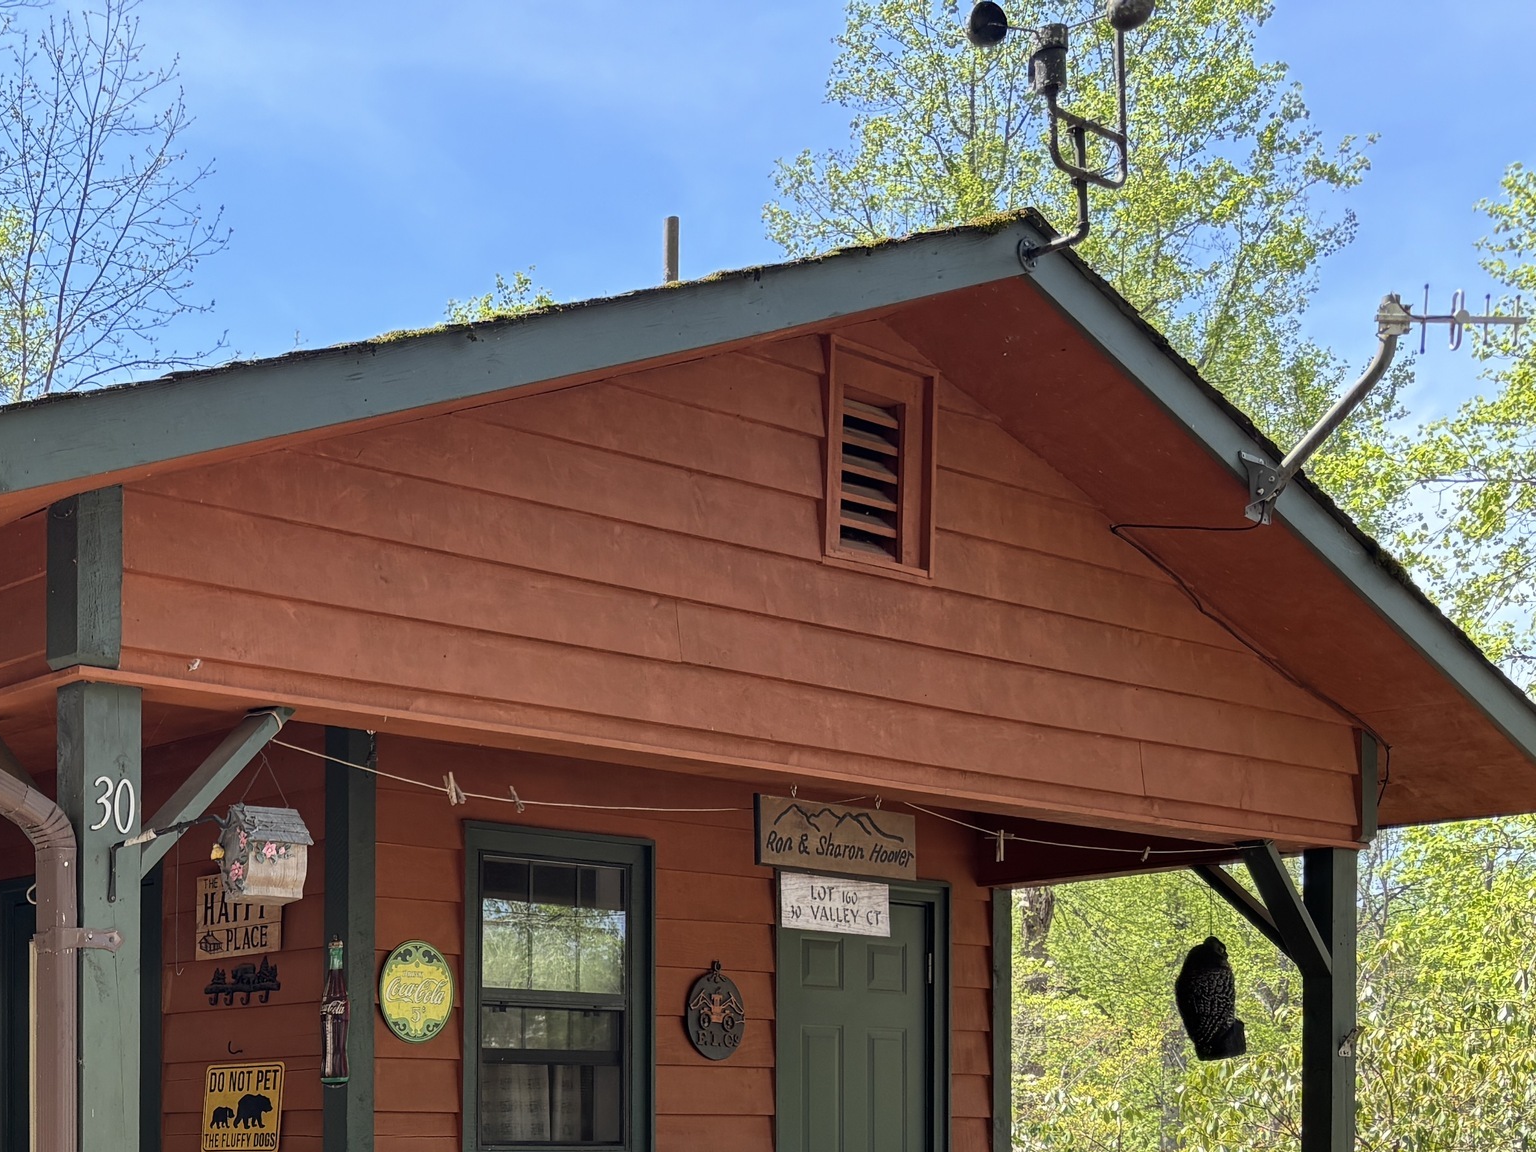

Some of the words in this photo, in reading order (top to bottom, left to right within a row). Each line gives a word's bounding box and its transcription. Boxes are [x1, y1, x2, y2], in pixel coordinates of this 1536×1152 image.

[90, 776, 135, 833] 30
[766, 830, 793, 853] Ron
[798, 833, 810, 855] &
[816, 832, 865, 860] Sharon
[869, 843, 915, 867] Hoover
[204, 877, 218, 889] THE
[810, 884, 835, 902] LOT
[810, 905, 859, 923] VALLEY
[866, 910, 882, 925] CT
[226, 925, 268, 951] PLACE
[386, 976, 448, 1005] Coca-Cola
[209, 1072, 225, 1092] DO
[229, 1070, 253, 1092] NOT
[256, 1069, 279, 1091] PET
[205, 1133, 219, 1148] THE
[221, 1133, 251, 1148] FLUFFY
[253, 1132, 276, 1147] DOGS
